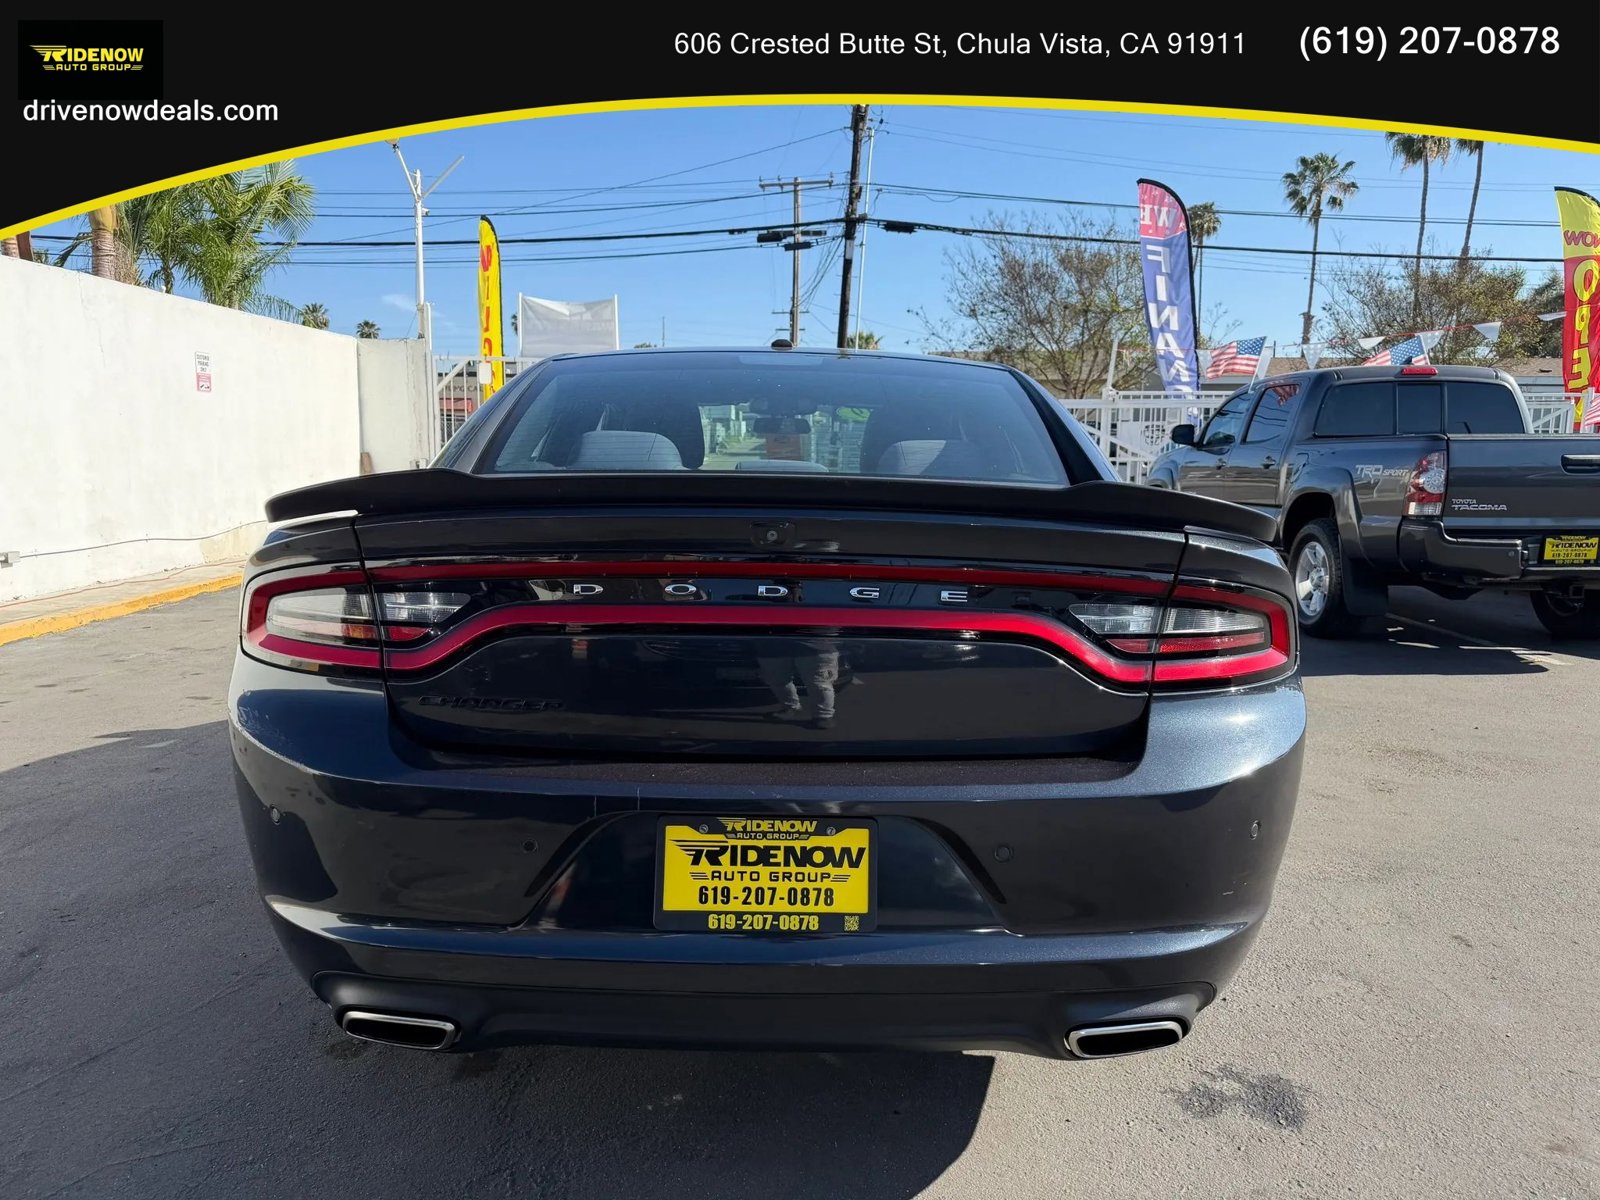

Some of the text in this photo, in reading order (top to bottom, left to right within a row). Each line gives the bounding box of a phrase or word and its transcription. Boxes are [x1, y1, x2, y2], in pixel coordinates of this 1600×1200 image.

[573, 583, 968, 602] DODGE
[717, 817, 818, 833] RIDENOW
[736, 832, 763, 840] AUTO
[670, 839, 867, 868] RIDENOW
[711, 870, 831, 883] AUTO GROUP
[698, 885, 835, 907] 619-207-0878
[708, 913, 819, 931] 619-207-0878
